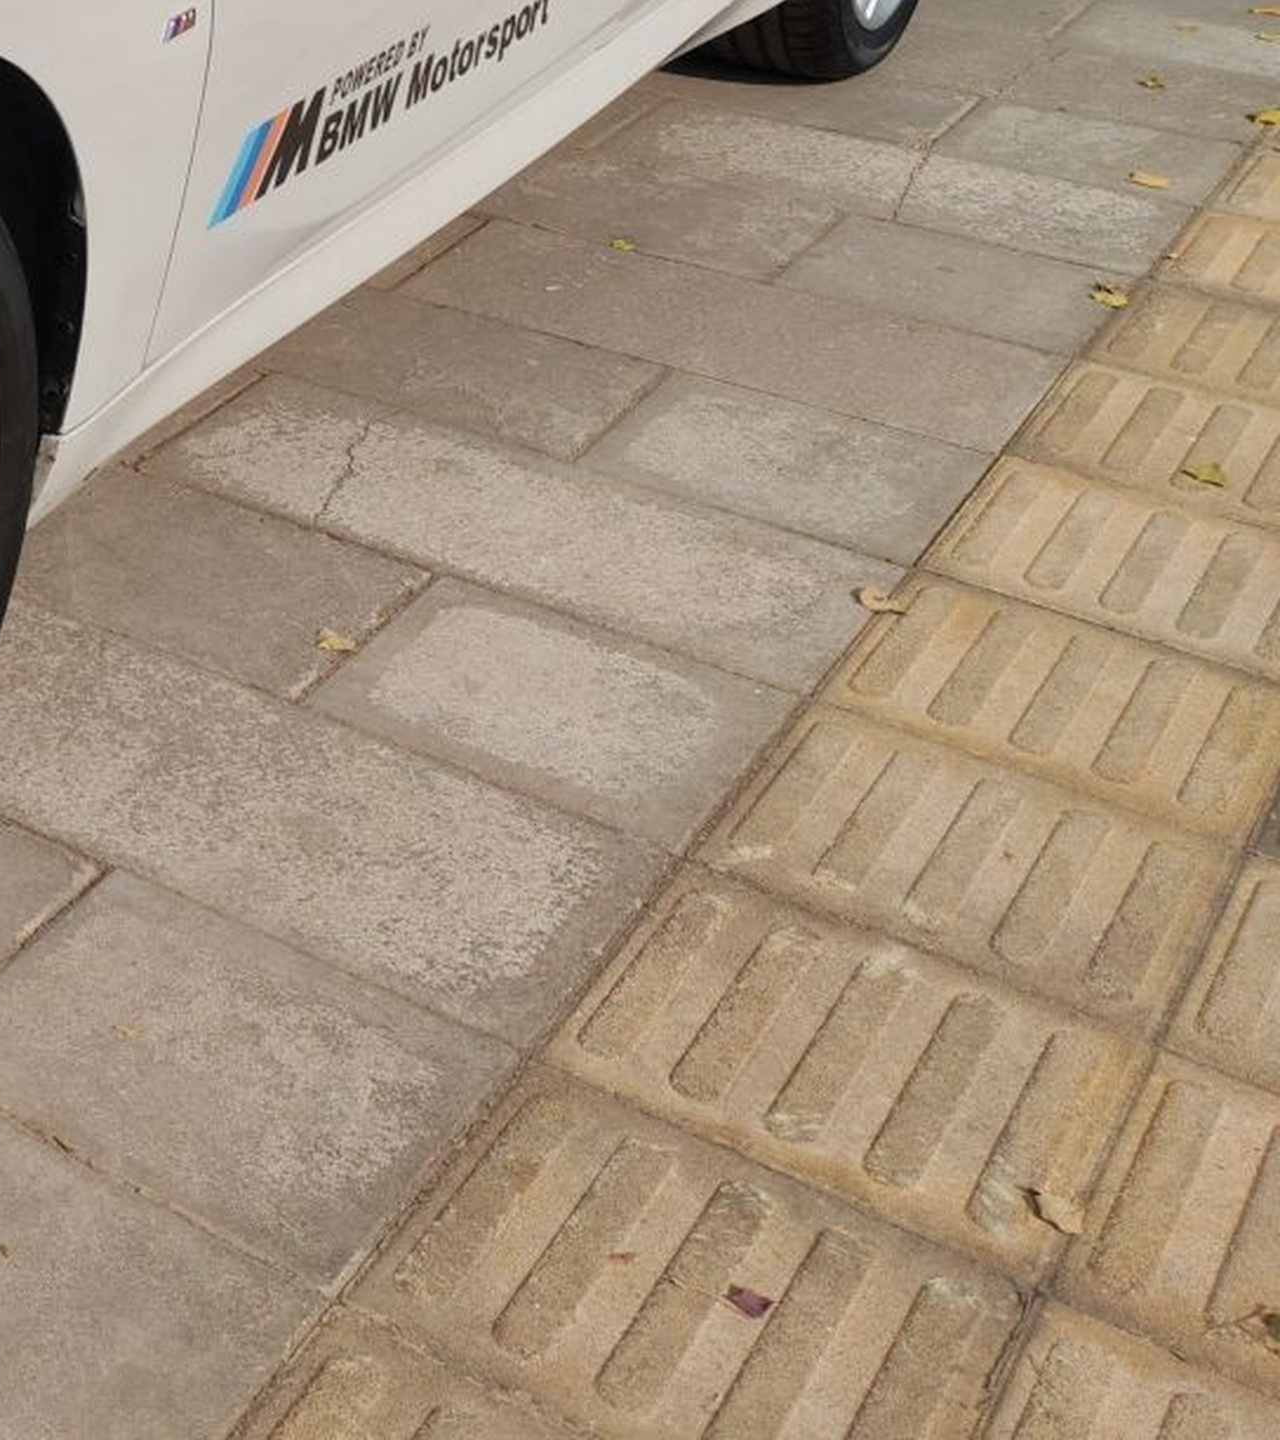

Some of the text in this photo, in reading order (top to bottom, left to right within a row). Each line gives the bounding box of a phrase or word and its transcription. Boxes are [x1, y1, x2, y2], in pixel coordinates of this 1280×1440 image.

[329, 25, 430, 106] POWERED BY
[254, 85, 327, 201] M
[315, 71, 404, 166] BMW
